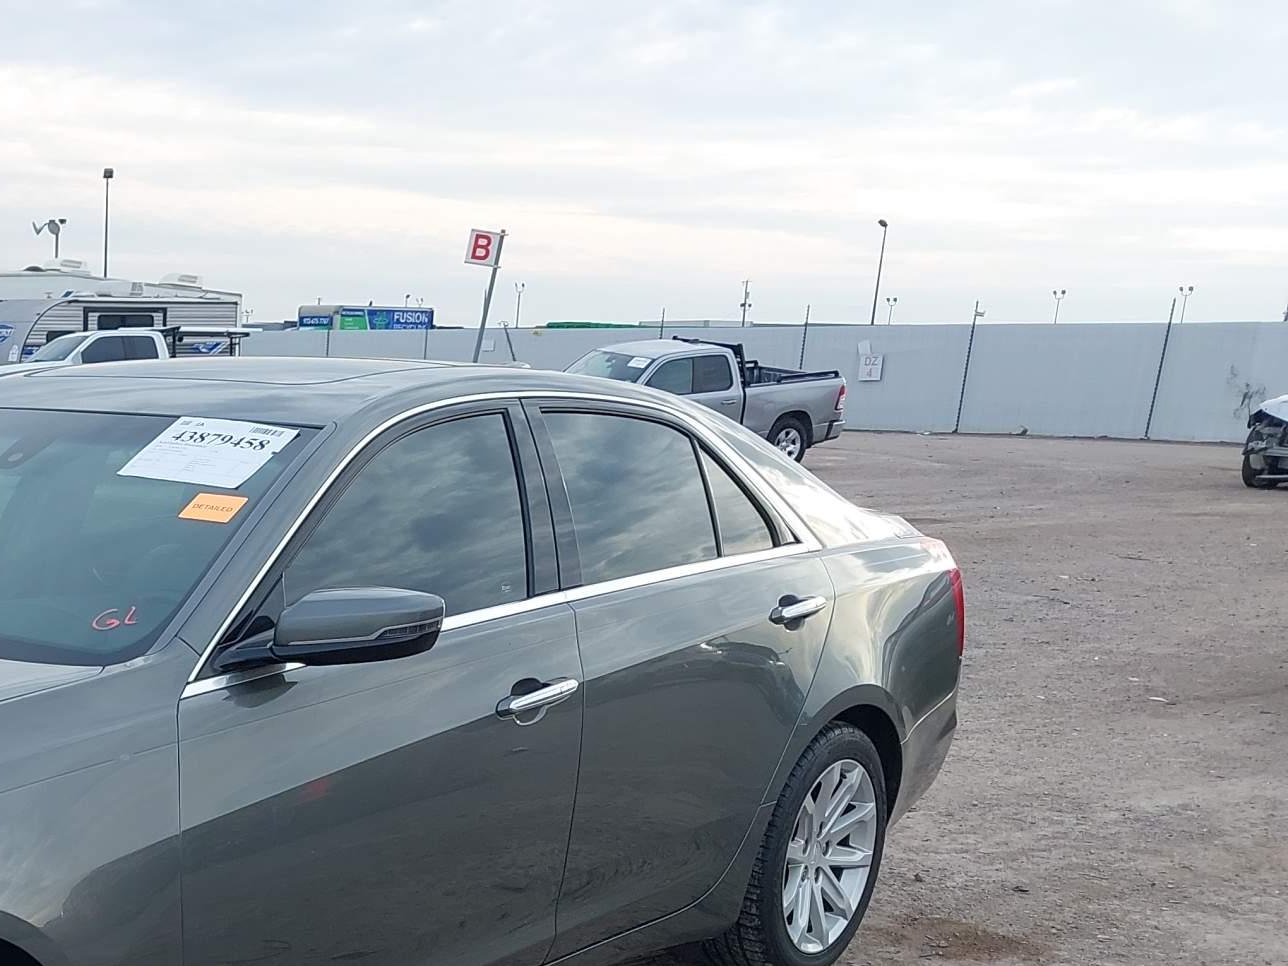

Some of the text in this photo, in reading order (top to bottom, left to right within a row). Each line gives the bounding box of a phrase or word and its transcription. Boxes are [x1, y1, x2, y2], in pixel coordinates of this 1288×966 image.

[471, 234, 492, 260] B
[393, 311, 428, 323] FUSION
[864, 356, 880, 366] DZ
[172, 430, 271, 450] 43879458
[191, 503, 234, 513] DETAILED
